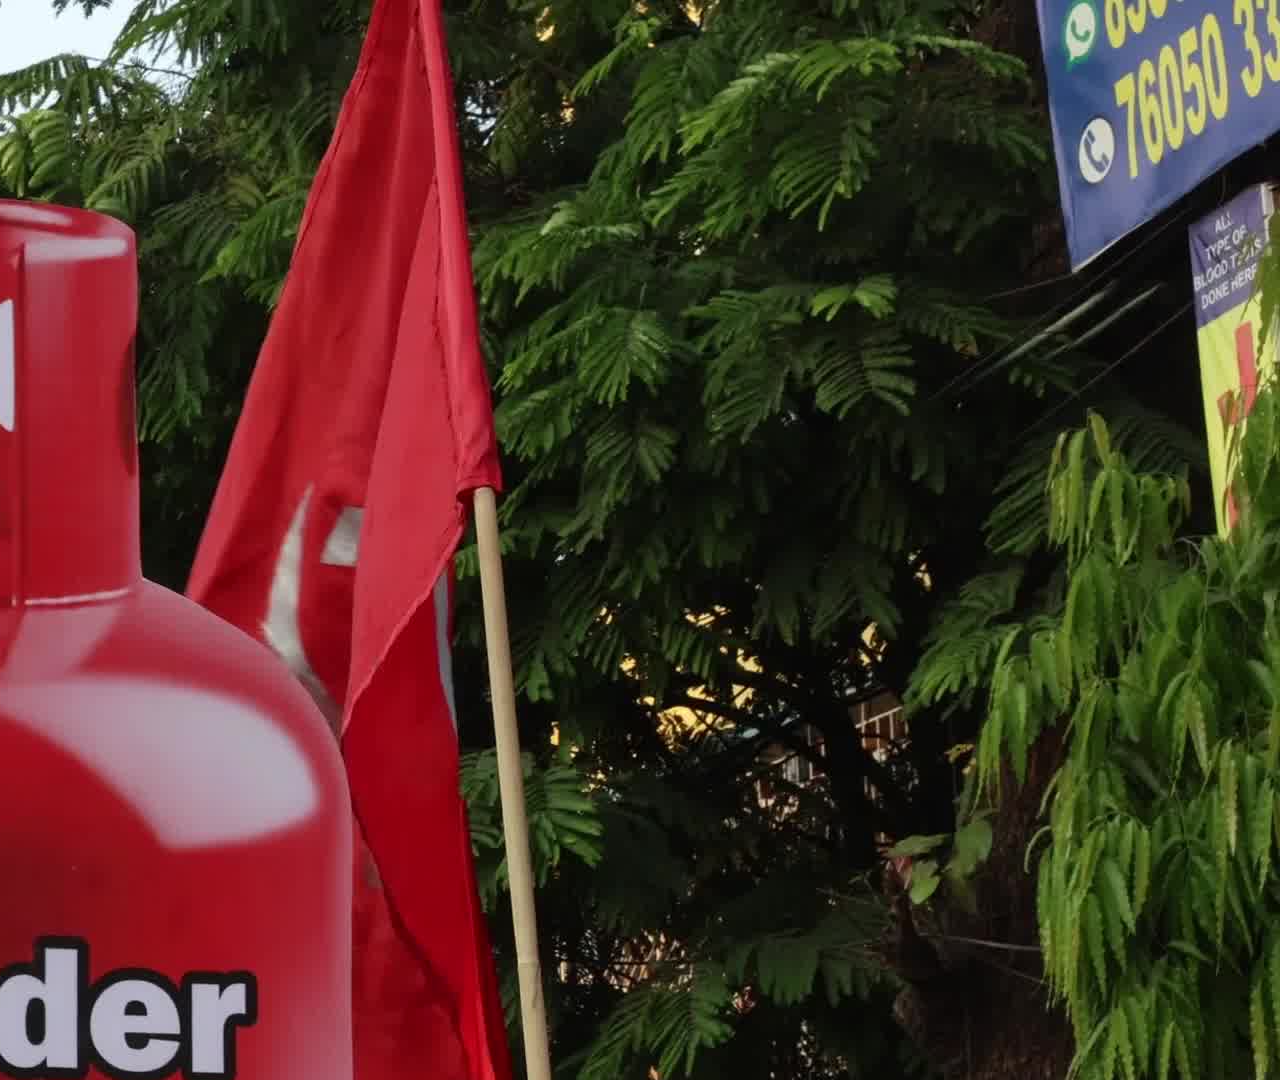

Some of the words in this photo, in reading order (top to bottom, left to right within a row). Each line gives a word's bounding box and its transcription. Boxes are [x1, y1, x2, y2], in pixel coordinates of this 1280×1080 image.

[1114, 13, 1229, 180] 76050
[1206, 235, 1231, 260] TYPE
[1193, 259, 1229, 292] BLOOD
[1201, 281, 1229, 310] DONE
